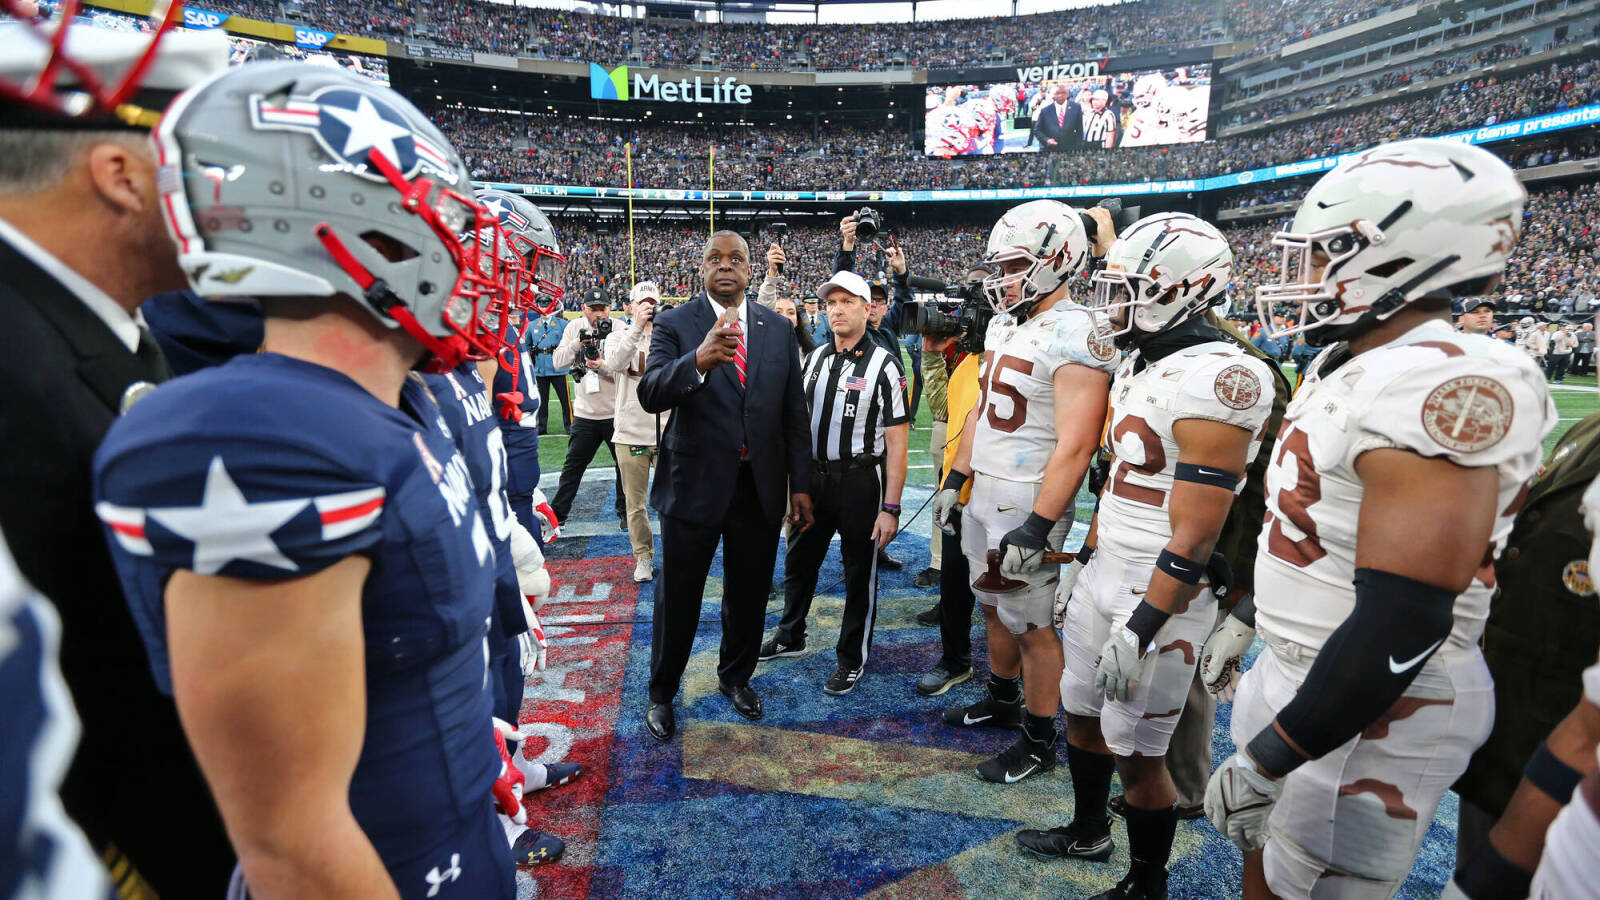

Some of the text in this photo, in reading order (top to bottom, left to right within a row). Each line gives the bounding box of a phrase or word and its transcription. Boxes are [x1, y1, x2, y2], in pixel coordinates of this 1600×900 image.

[184, 10, 220, 28] SAP
[296, 30, 327, 45] SAP
[1017, 61, 1099, 83] verizon
[634, 73, 753, 104] MetLife
[1477, 124, 1520, 140] Game
[1523, 107, 1600, 135] presente
[1276, 161, 1322, 176] Welcome
[1324, 158, 1337, 168] to
[526, 186, 568, 195] BALL ON
[1102, 183, 1151, 195] presented
[1152, 182, 1165, 192] by
[1166, 180, 1195, 190] USAA
[640, 285, 655, 293] ARMY
[844, 403, 855, 417] R
[1106, 406, 1167, 508] 2
[1263, 418, 1328, 568] 3
